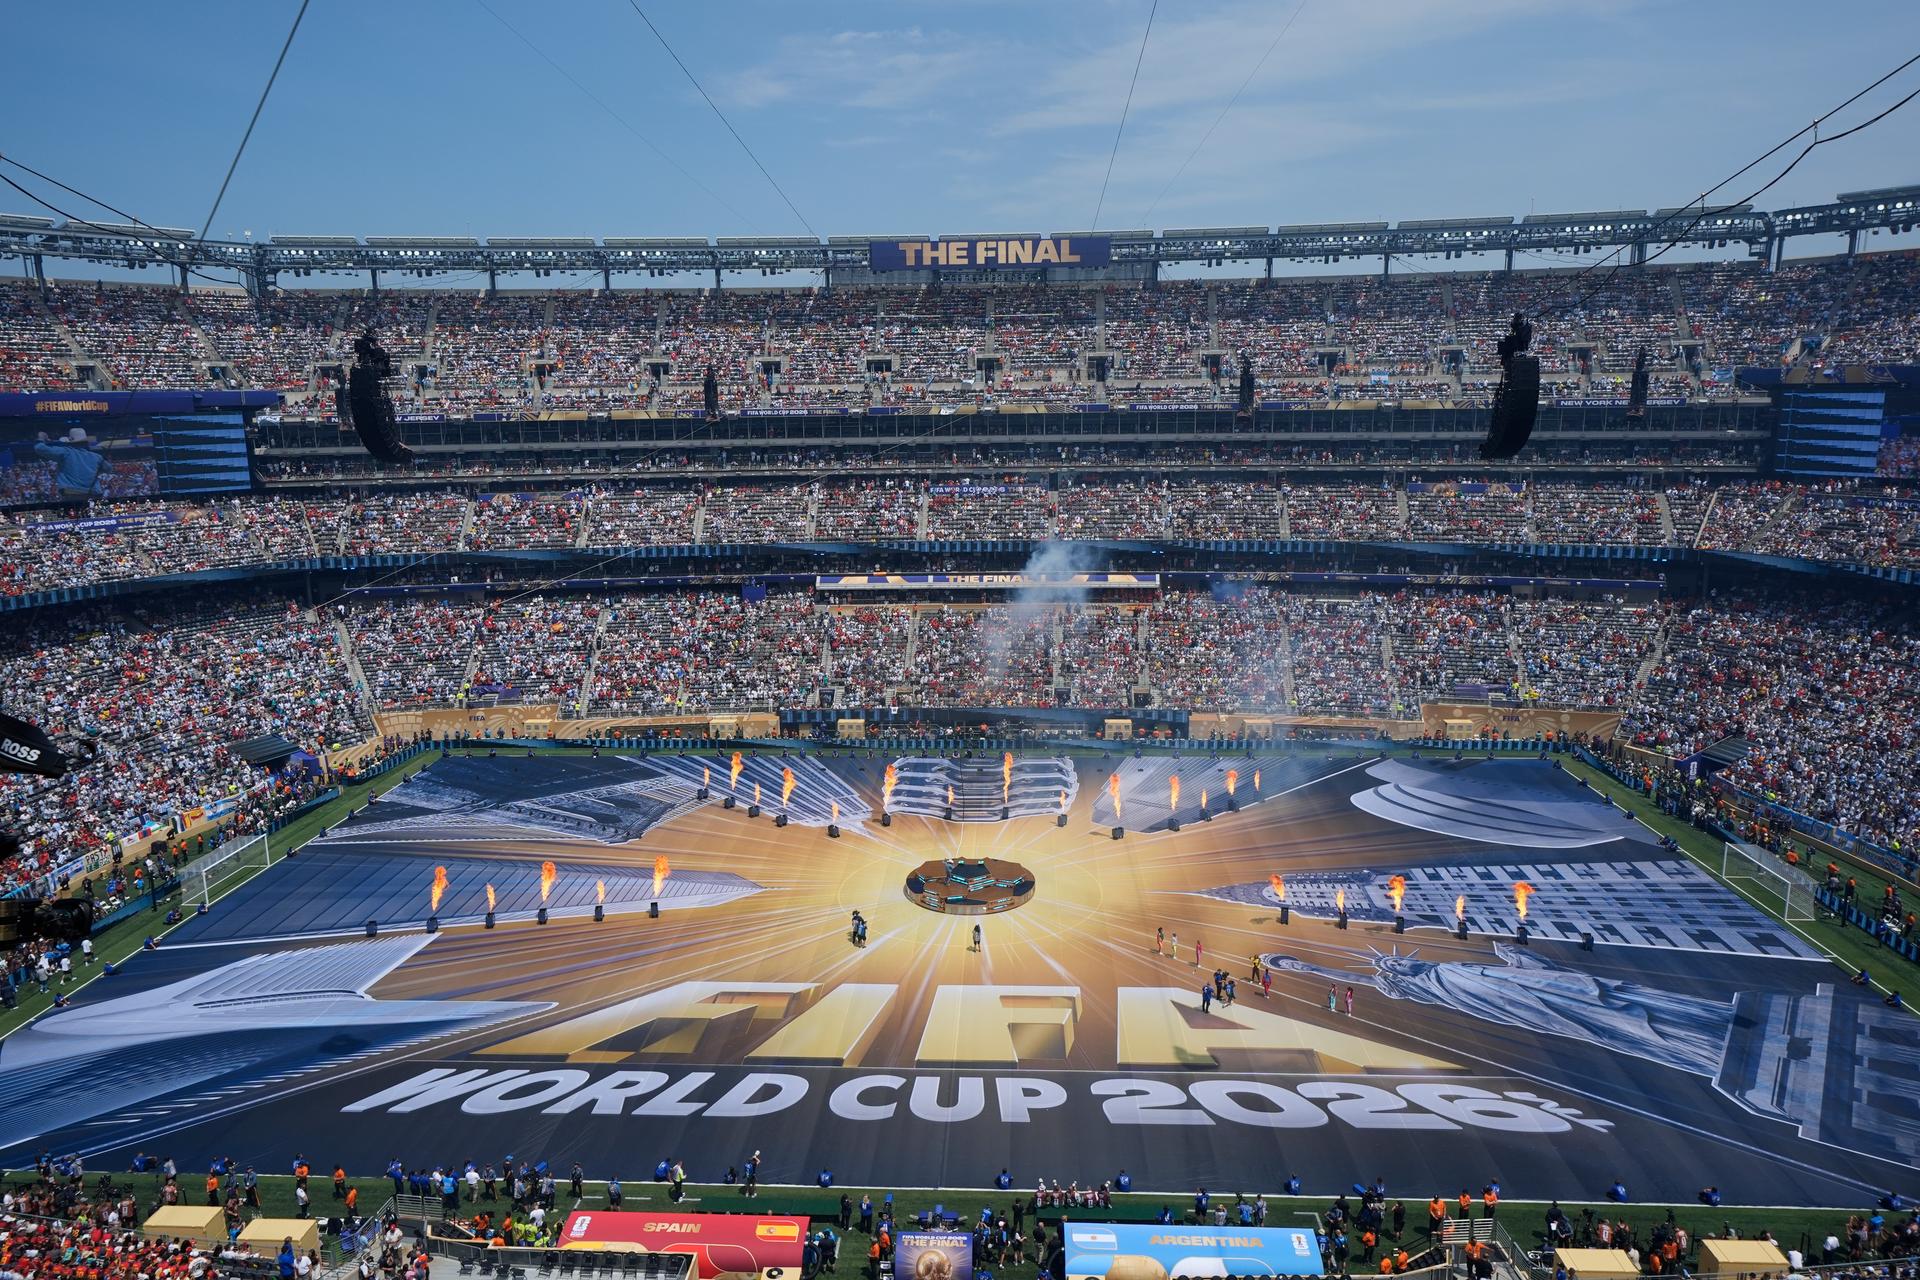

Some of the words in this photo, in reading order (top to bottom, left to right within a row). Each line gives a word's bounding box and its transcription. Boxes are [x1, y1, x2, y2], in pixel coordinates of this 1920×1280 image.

[899, 242, 969, 266] THE
[976, 239, 1081, 265] FINAL
[35, 400, 109, 412] #FIFAWorldCup
[946, 575, 980, 583] THE
[1, 738, 41, 761] ROSS
[470, 981, 1474, 1070] FIFA
[340, 1068, 809, 1117] WORLD
[828, 1074, 1068, 1124] CUP
[1090, 1078, 1573, 1133] 2026
[643, 1222, 702, 1233] SPAIN
[903, 1239, 927, 1247] THE
[929, 1239, 967, 1247] FINAL
[1151, 1235, 1264, 1248] ARGENTINA
